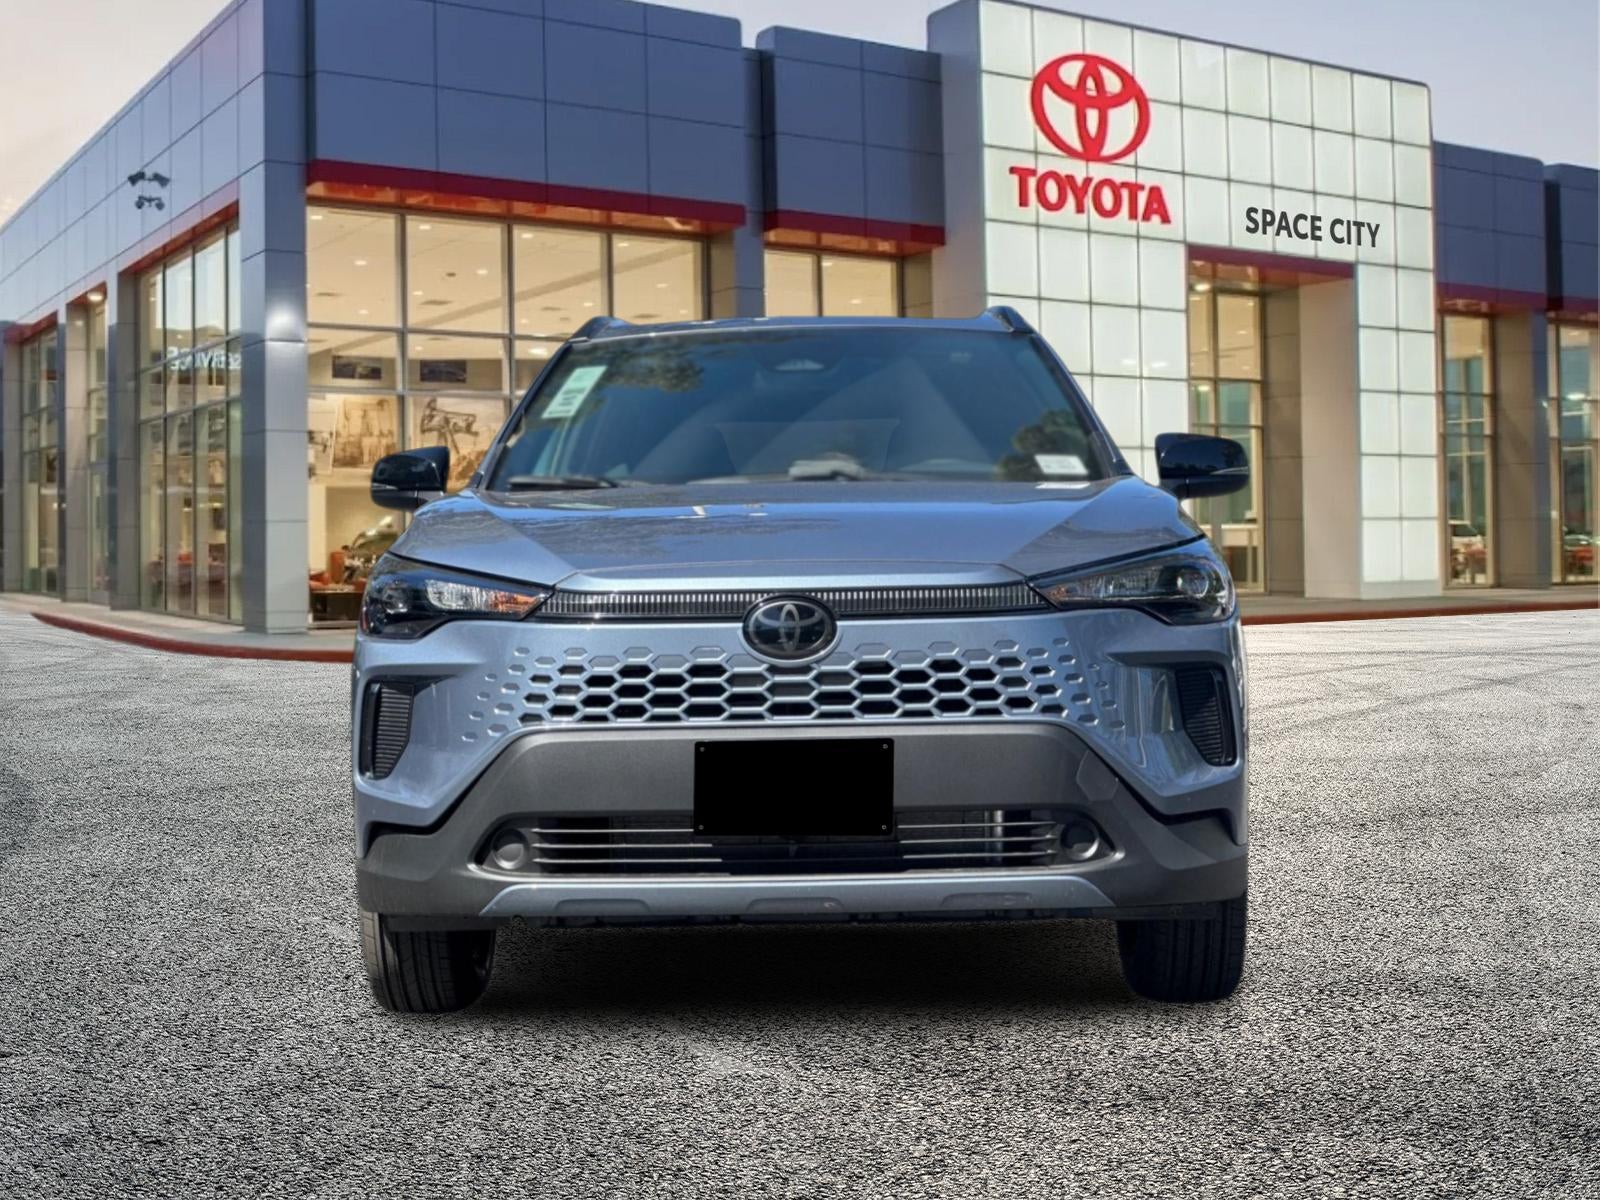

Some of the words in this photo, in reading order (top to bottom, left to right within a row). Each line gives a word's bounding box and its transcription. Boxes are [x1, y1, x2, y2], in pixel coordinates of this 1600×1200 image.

[1009, 166, 1171, 224] TOYOTA
[1245, 206, 1323, 242] SPACE
[1329, 218, 1381, 248] CITY
